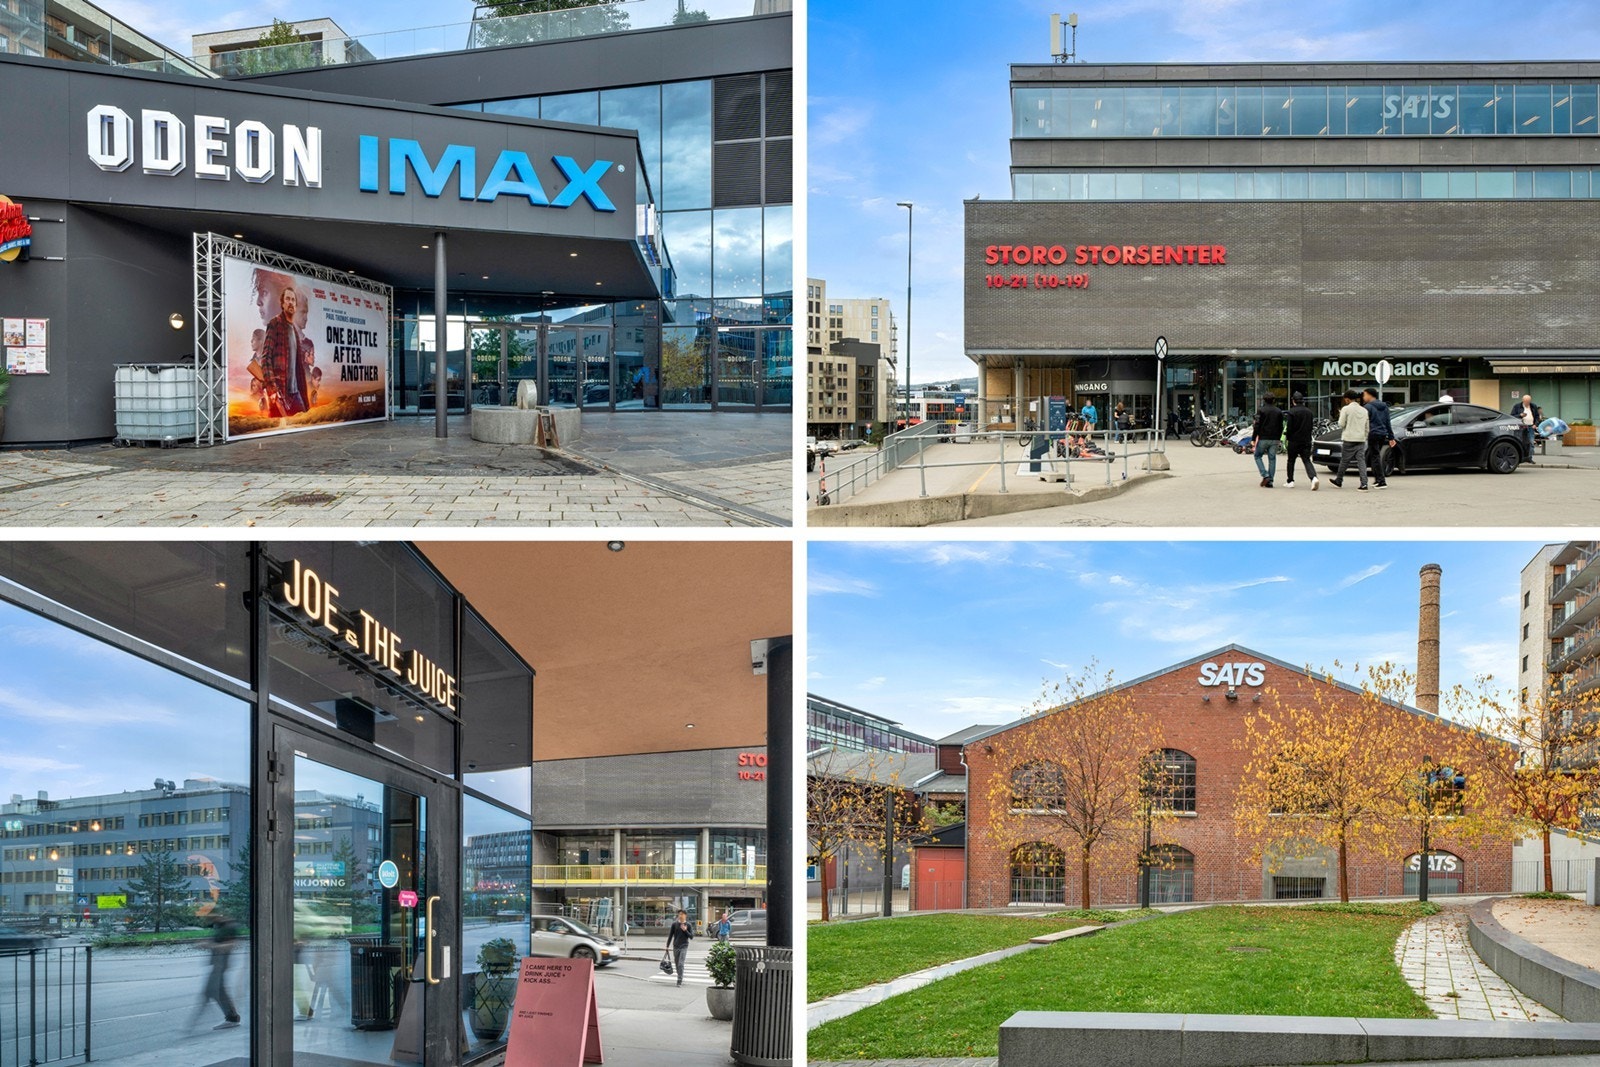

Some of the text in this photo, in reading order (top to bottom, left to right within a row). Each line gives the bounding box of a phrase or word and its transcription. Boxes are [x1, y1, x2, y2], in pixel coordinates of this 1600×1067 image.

[1380, 94, 1455, 119] SATS
[86, 104, 617, 212] ODEON IMAX
[985, 245, 1228, 265] STORO STORSENTER
[985, 273, 1090, 290] 10-21 (10-19)
[326, 325, 378, 348] ONE BATTLE
[333, 346, 362, 364] AFTER
[340, 364, 379, 382] ANOTHER
[284, 559, 456, 712] JOE & THE JUICE
[1197, 662, 1266, 687] SATS
[738, 752, 768, 767] STO
[738, 770, 765, 781] 10-21
